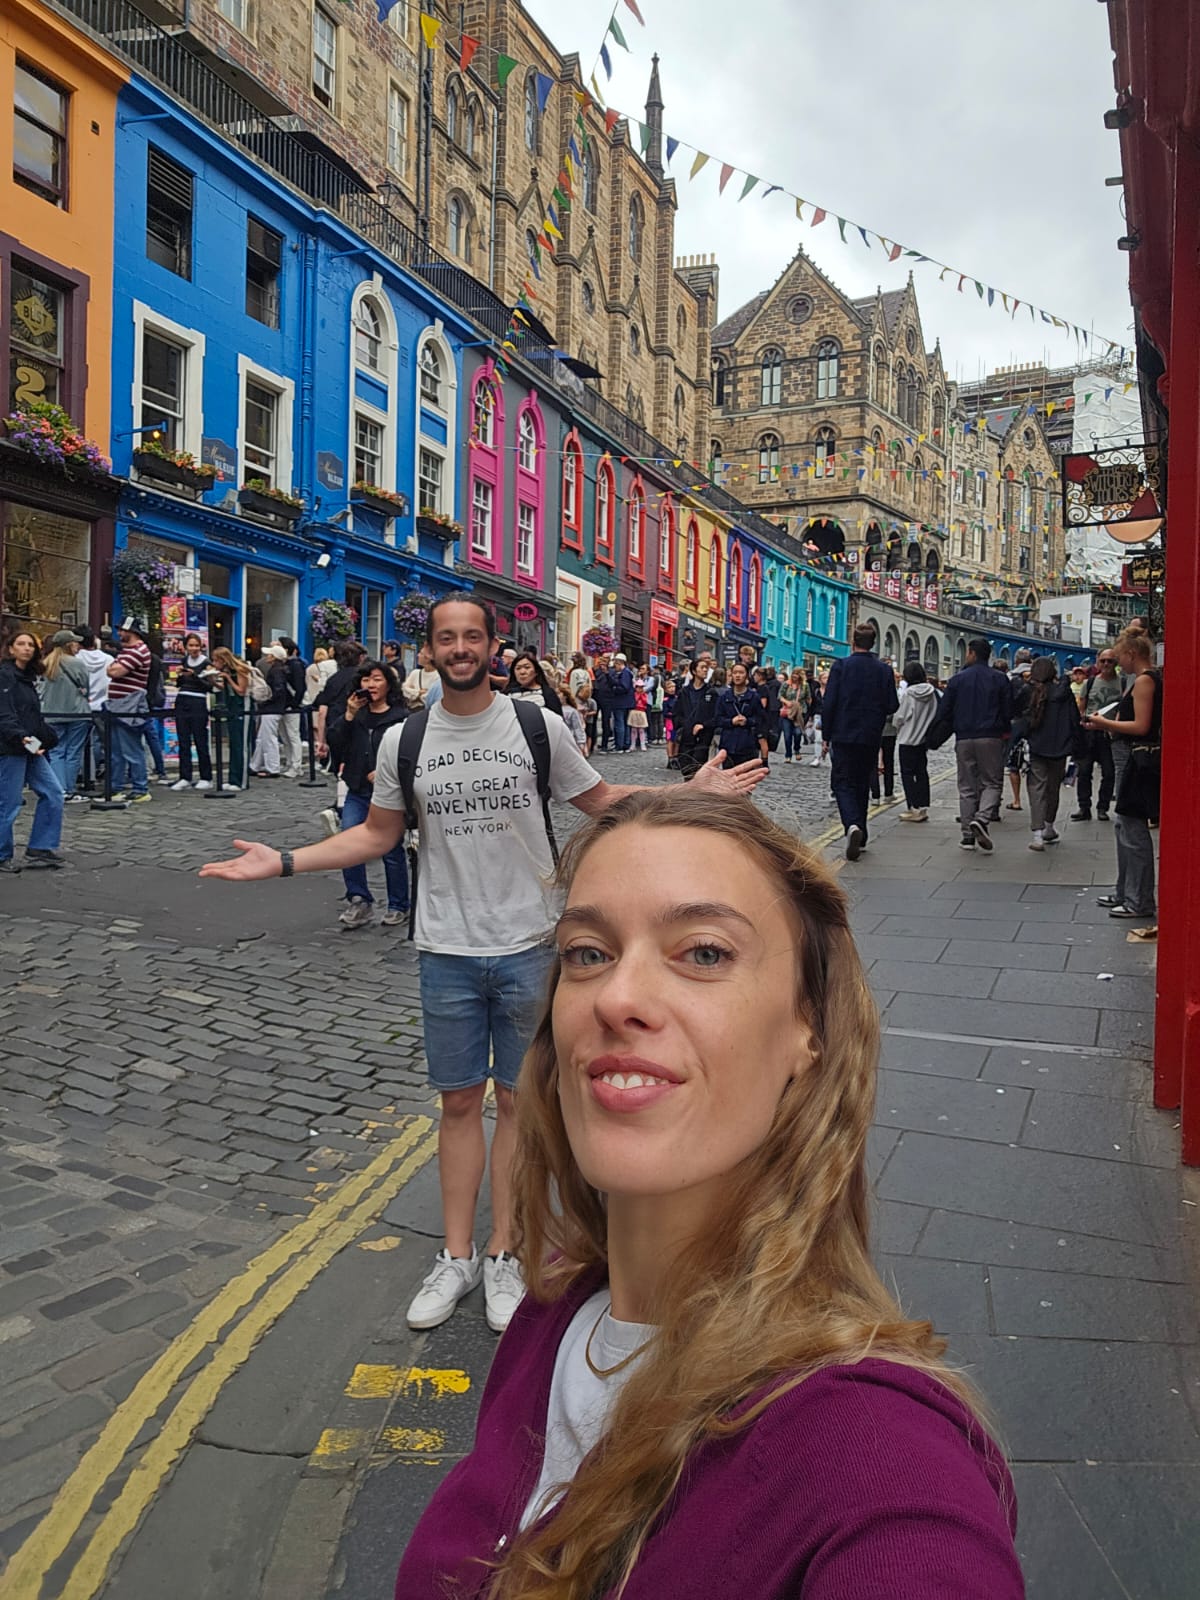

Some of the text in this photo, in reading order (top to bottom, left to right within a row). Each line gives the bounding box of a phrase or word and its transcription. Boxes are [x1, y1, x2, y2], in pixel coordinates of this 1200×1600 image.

[1097, 487, 1129, 504] TOURS
[415, 748, 539, 778] O BAD DECISIONS
[427, 776, 518, 797] JUST GREAT
[427, 793, 531, 816] ADVENTURES
[445, 821, 512, 837] NEW YORK
